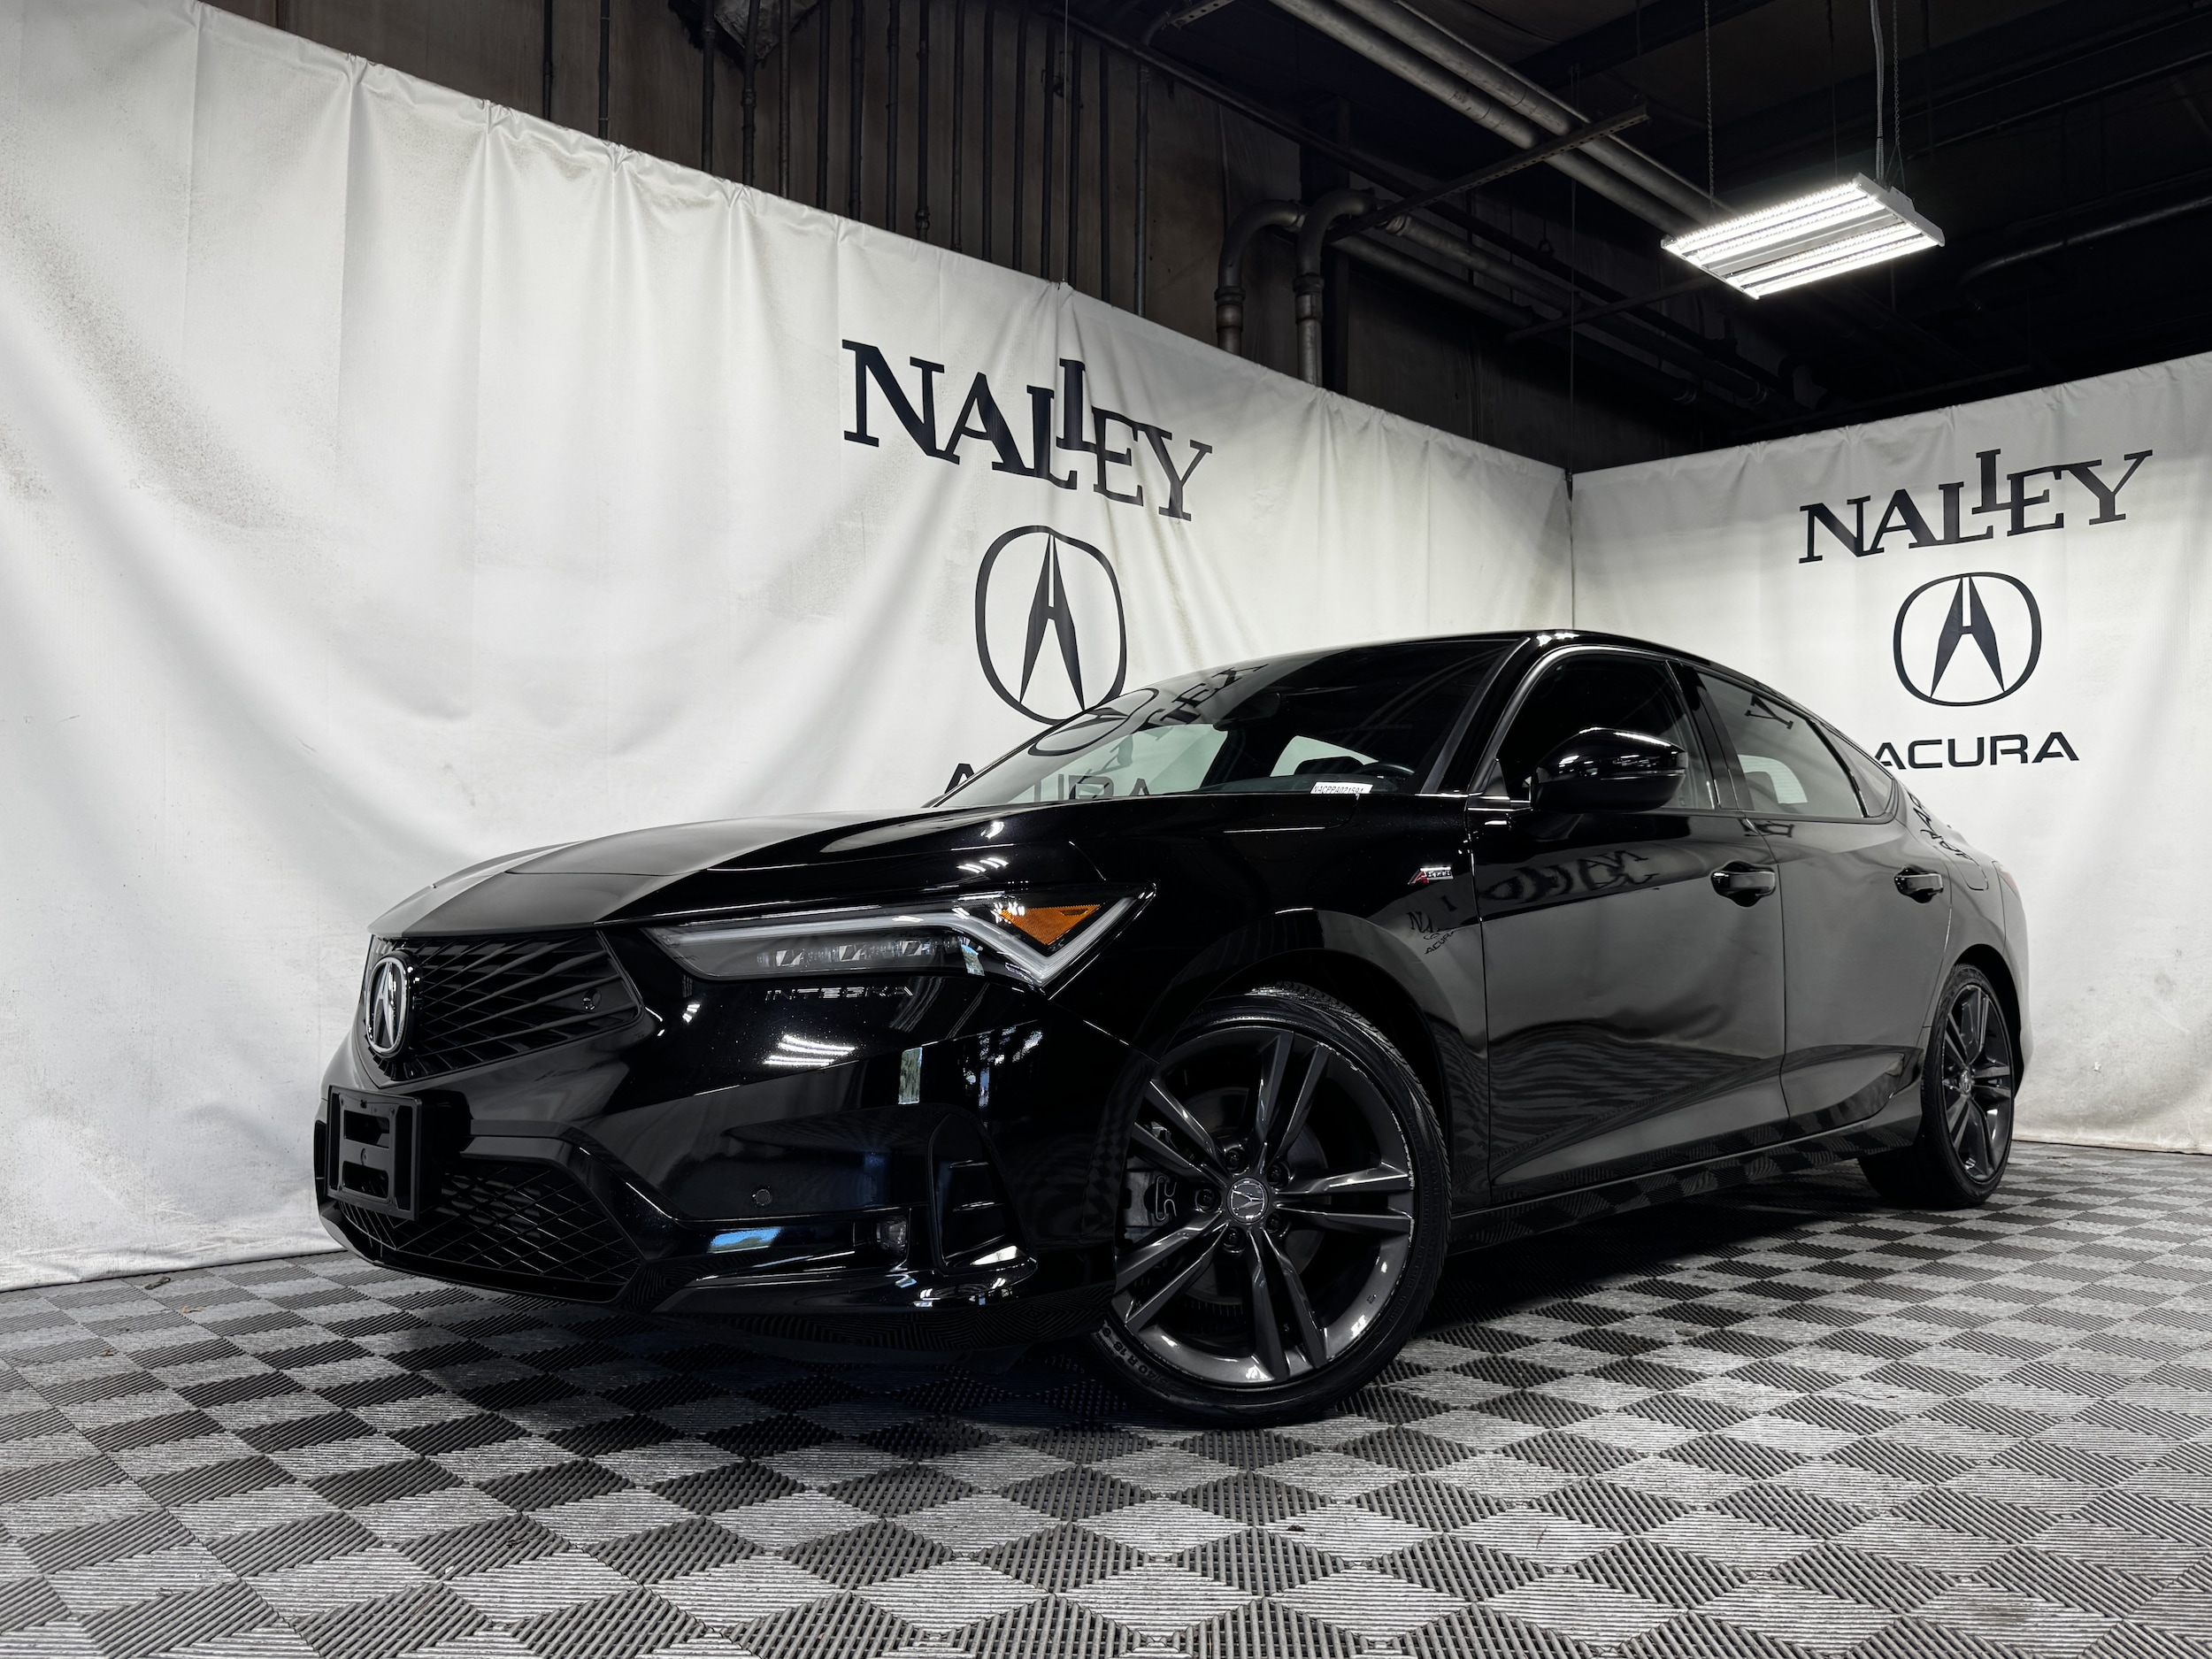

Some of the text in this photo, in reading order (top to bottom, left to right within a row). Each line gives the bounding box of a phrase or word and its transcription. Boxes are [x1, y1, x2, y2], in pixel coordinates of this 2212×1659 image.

[841, 339, 1212, 521] NALLEY
[1799, 449, 2153, 564] NALLEY
[1874, 732, 2079, 770] ACURA
